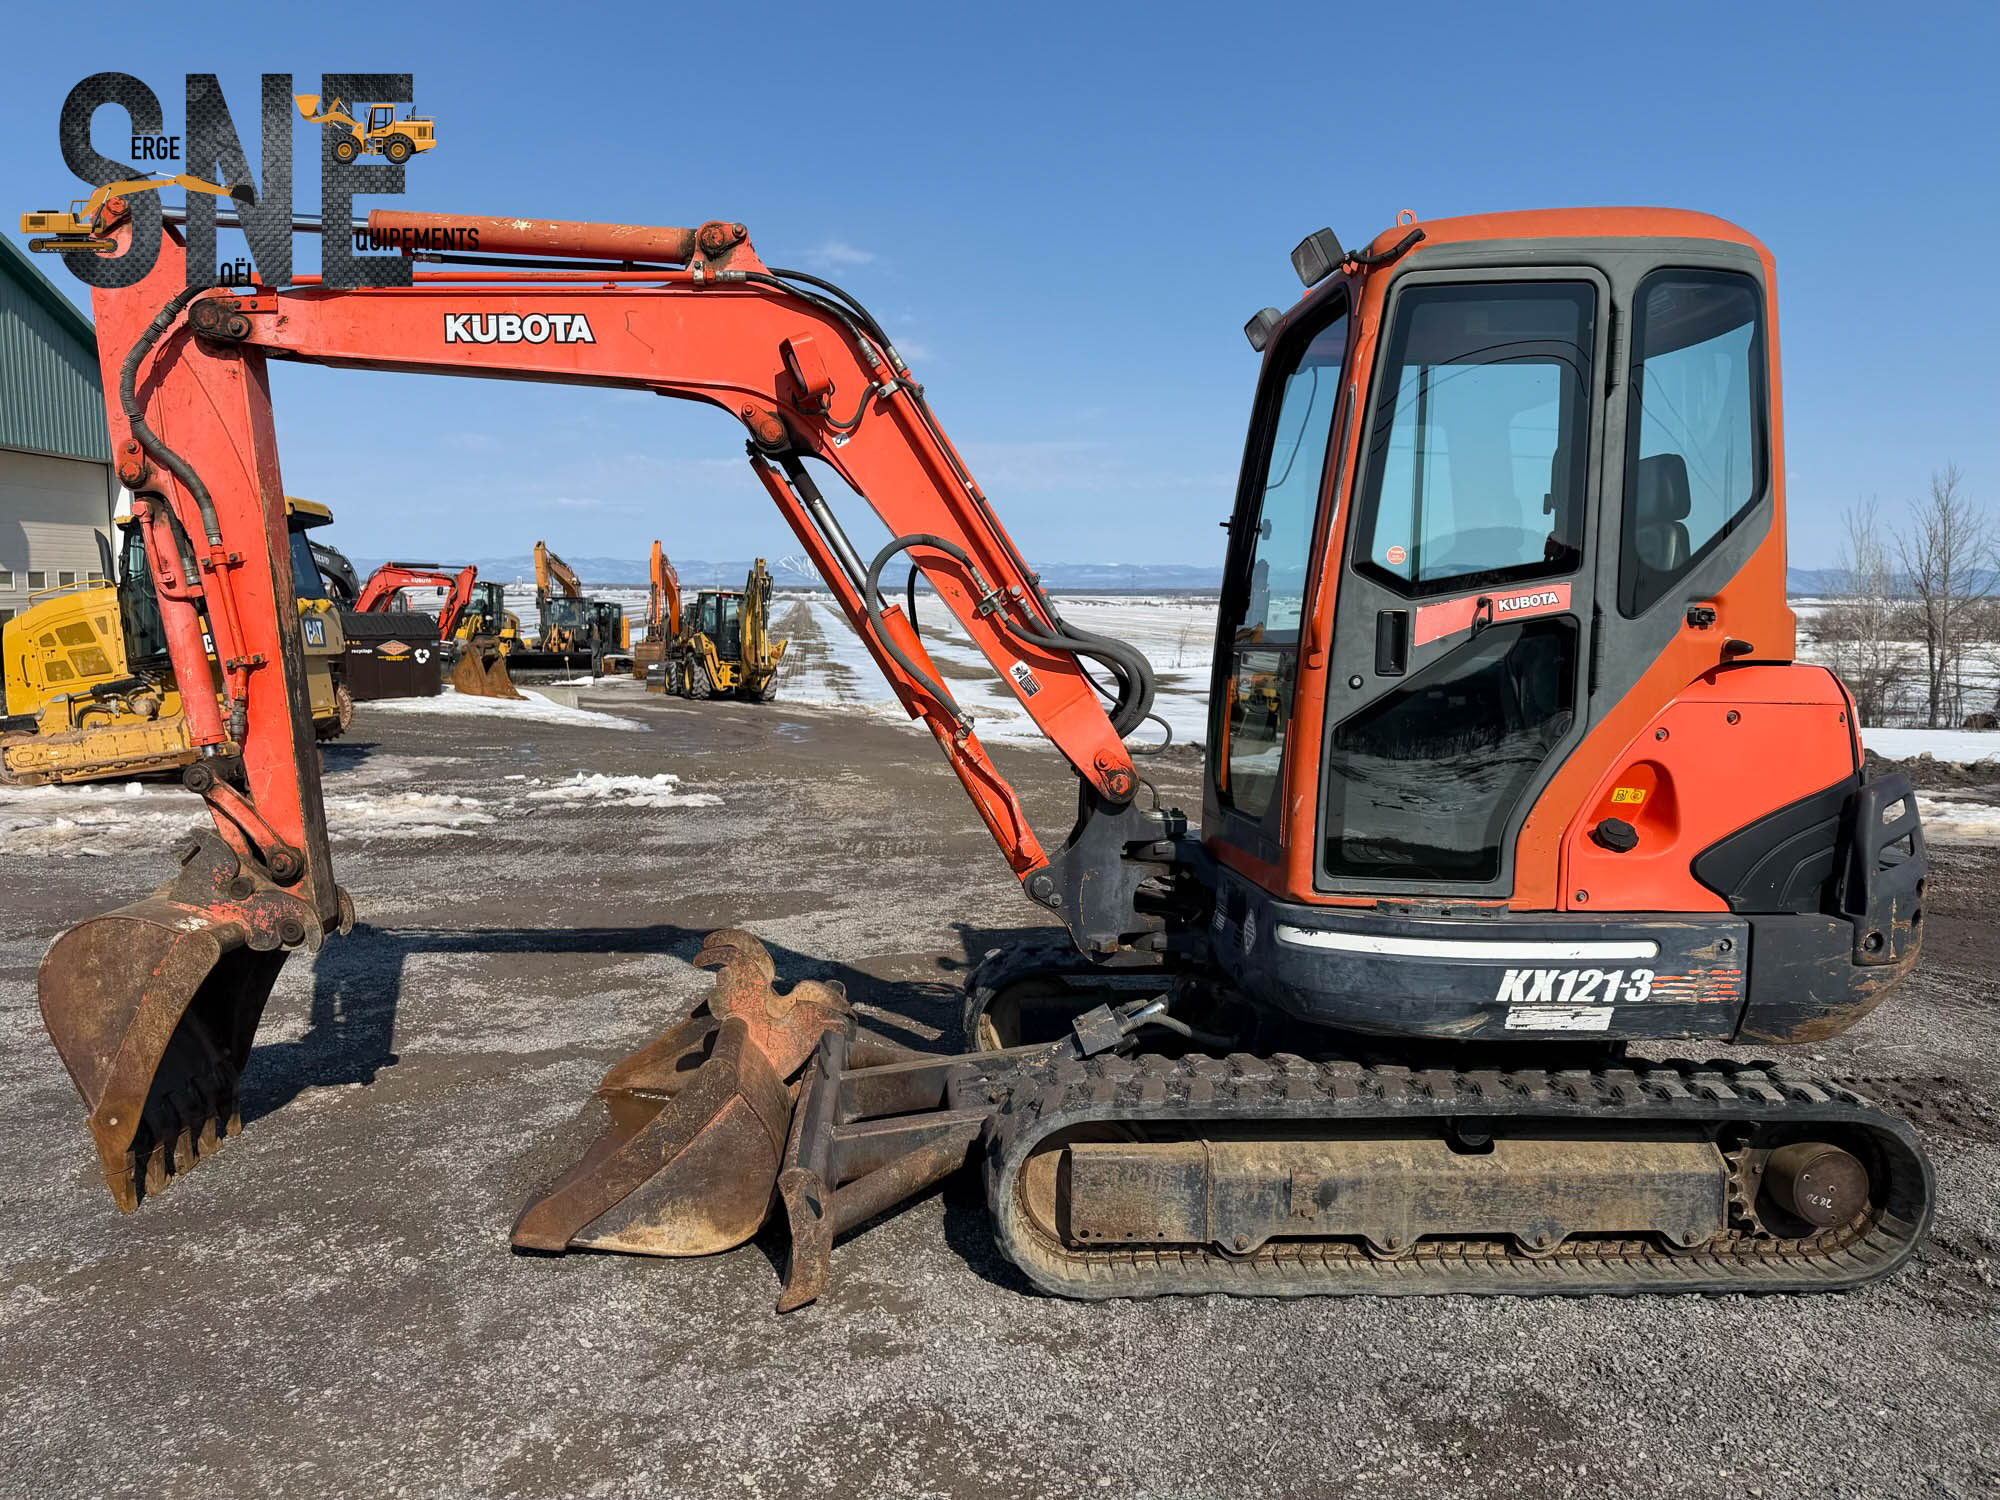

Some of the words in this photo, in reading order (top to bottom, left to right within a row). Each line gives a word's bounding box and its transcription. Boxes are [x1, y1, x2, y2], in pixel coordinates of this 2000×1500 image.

[444, 312, 596, 344] KUBOTA
[1498, 592, 1559, 612] KUBOTA
[304, 620, 325, 645] CAT
[1496, 969, 1655, 1002] KX121-3
